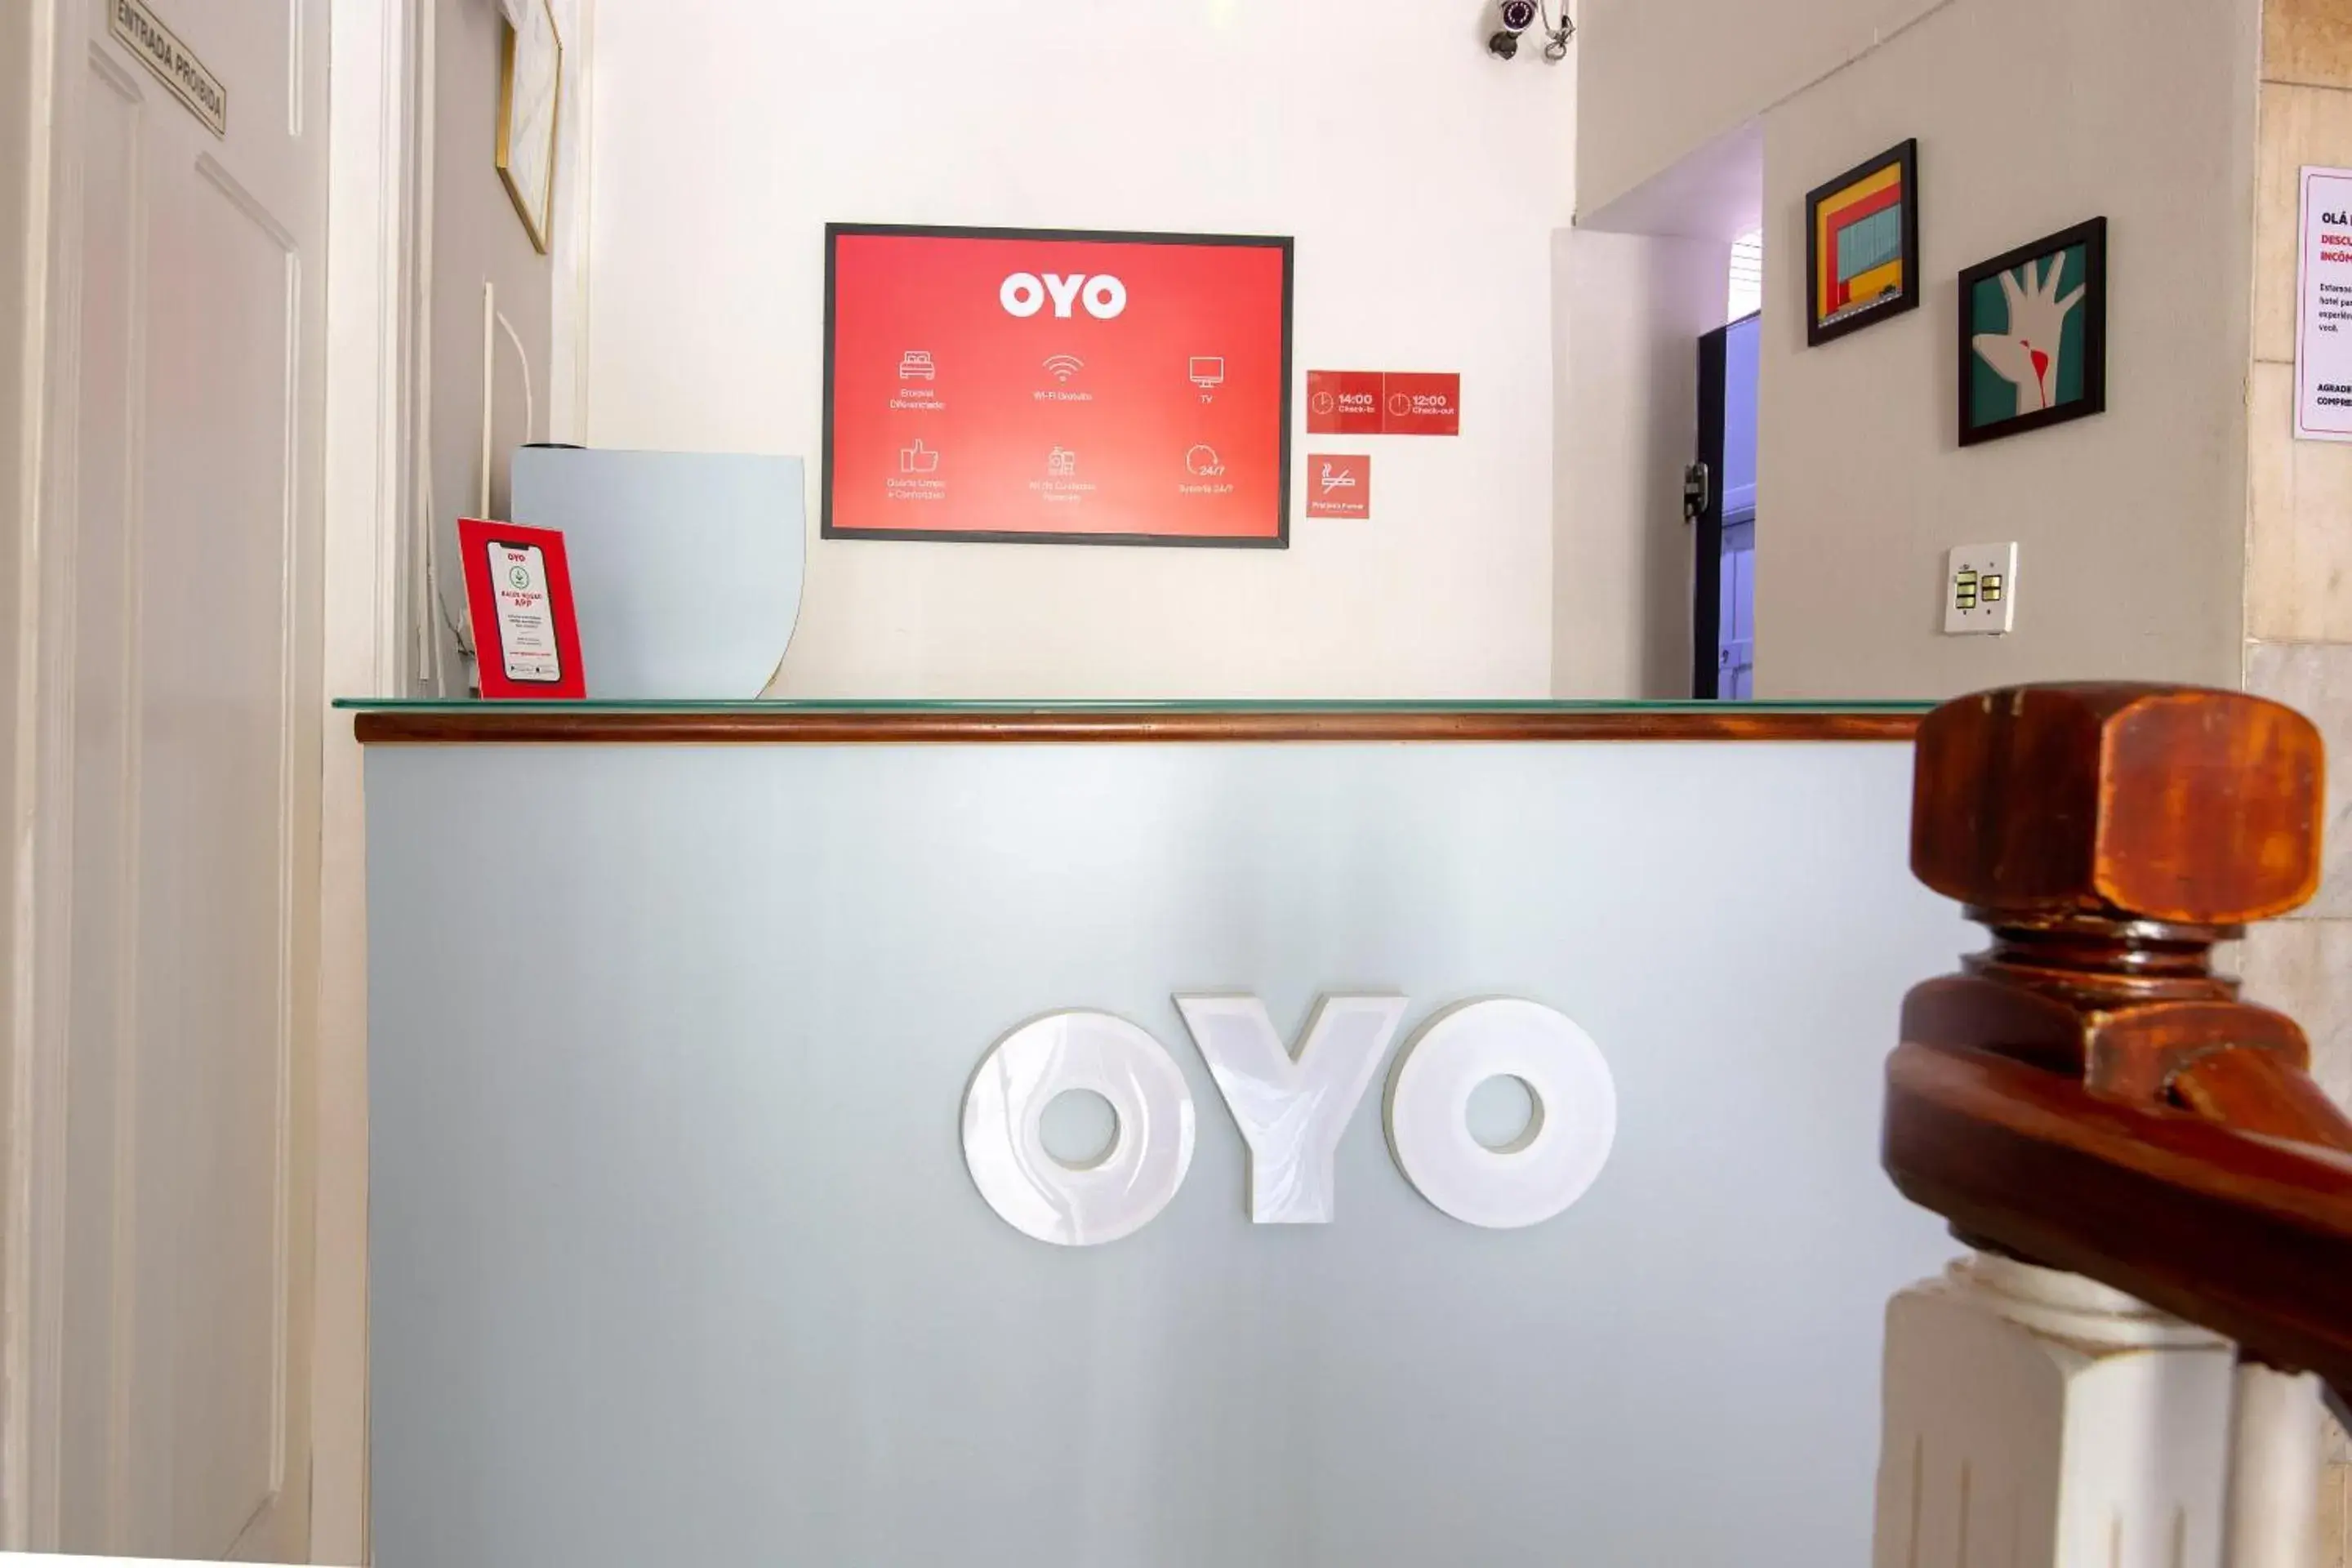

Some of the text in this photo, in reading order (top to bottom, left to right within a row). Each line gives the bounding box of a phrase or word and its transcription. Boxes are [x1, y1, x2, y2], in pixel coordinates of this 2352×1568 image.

[118, 1, 220, 118] ENTRADA PROIBIDA
[2322, 211, 2348, 225] OLÁ
[1000, 272, 1127, 319] OYO
[1200, 394, 1213, 403] TV
[1339, 394, 1373, 405] 14:00
[1412, 395, 1446, 406] 12:00
[1339, 405, 1375, 414] Check-in
[1412, 407, 1454, 416] Check-out
[1200, 465, 1225, 475] 24/7
[507, 553, 526, 562] OYO
[514, 599, 532, 608] APP
[960, 992, 1617, 1245] OYO
